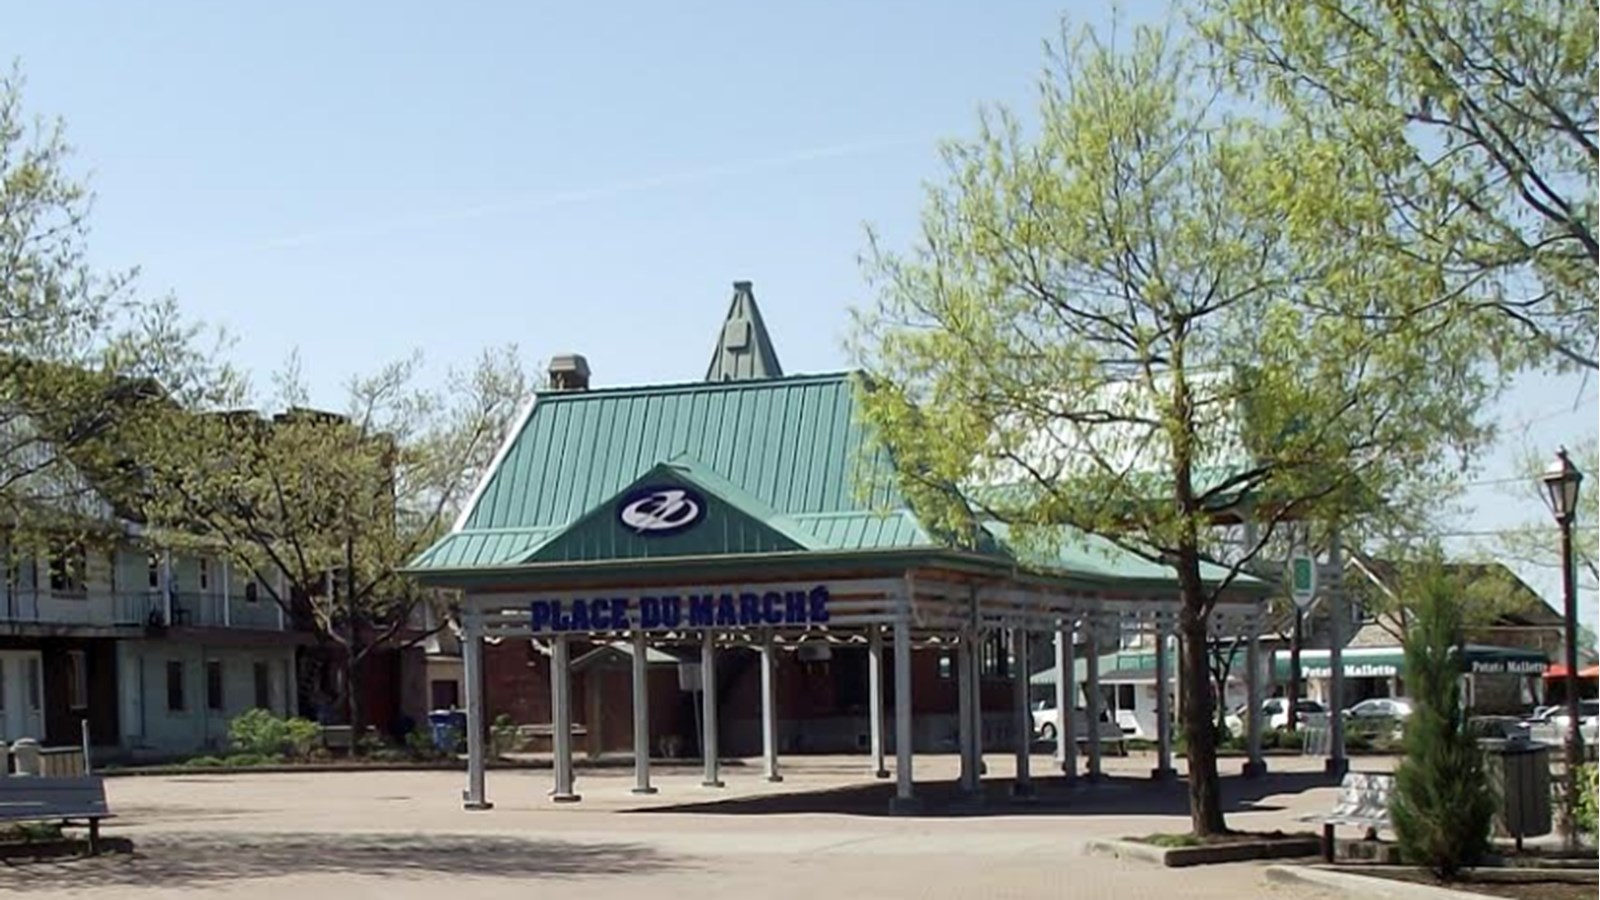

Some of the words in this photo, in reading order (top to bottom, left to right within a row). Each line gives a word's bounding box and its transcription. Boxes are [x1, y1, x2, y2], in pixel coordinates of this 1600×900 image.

[531, 598, 629, 631] PLACE
[639, 595, 681, 629] DU
[689, 585, 830, 627] MARCHÉ
